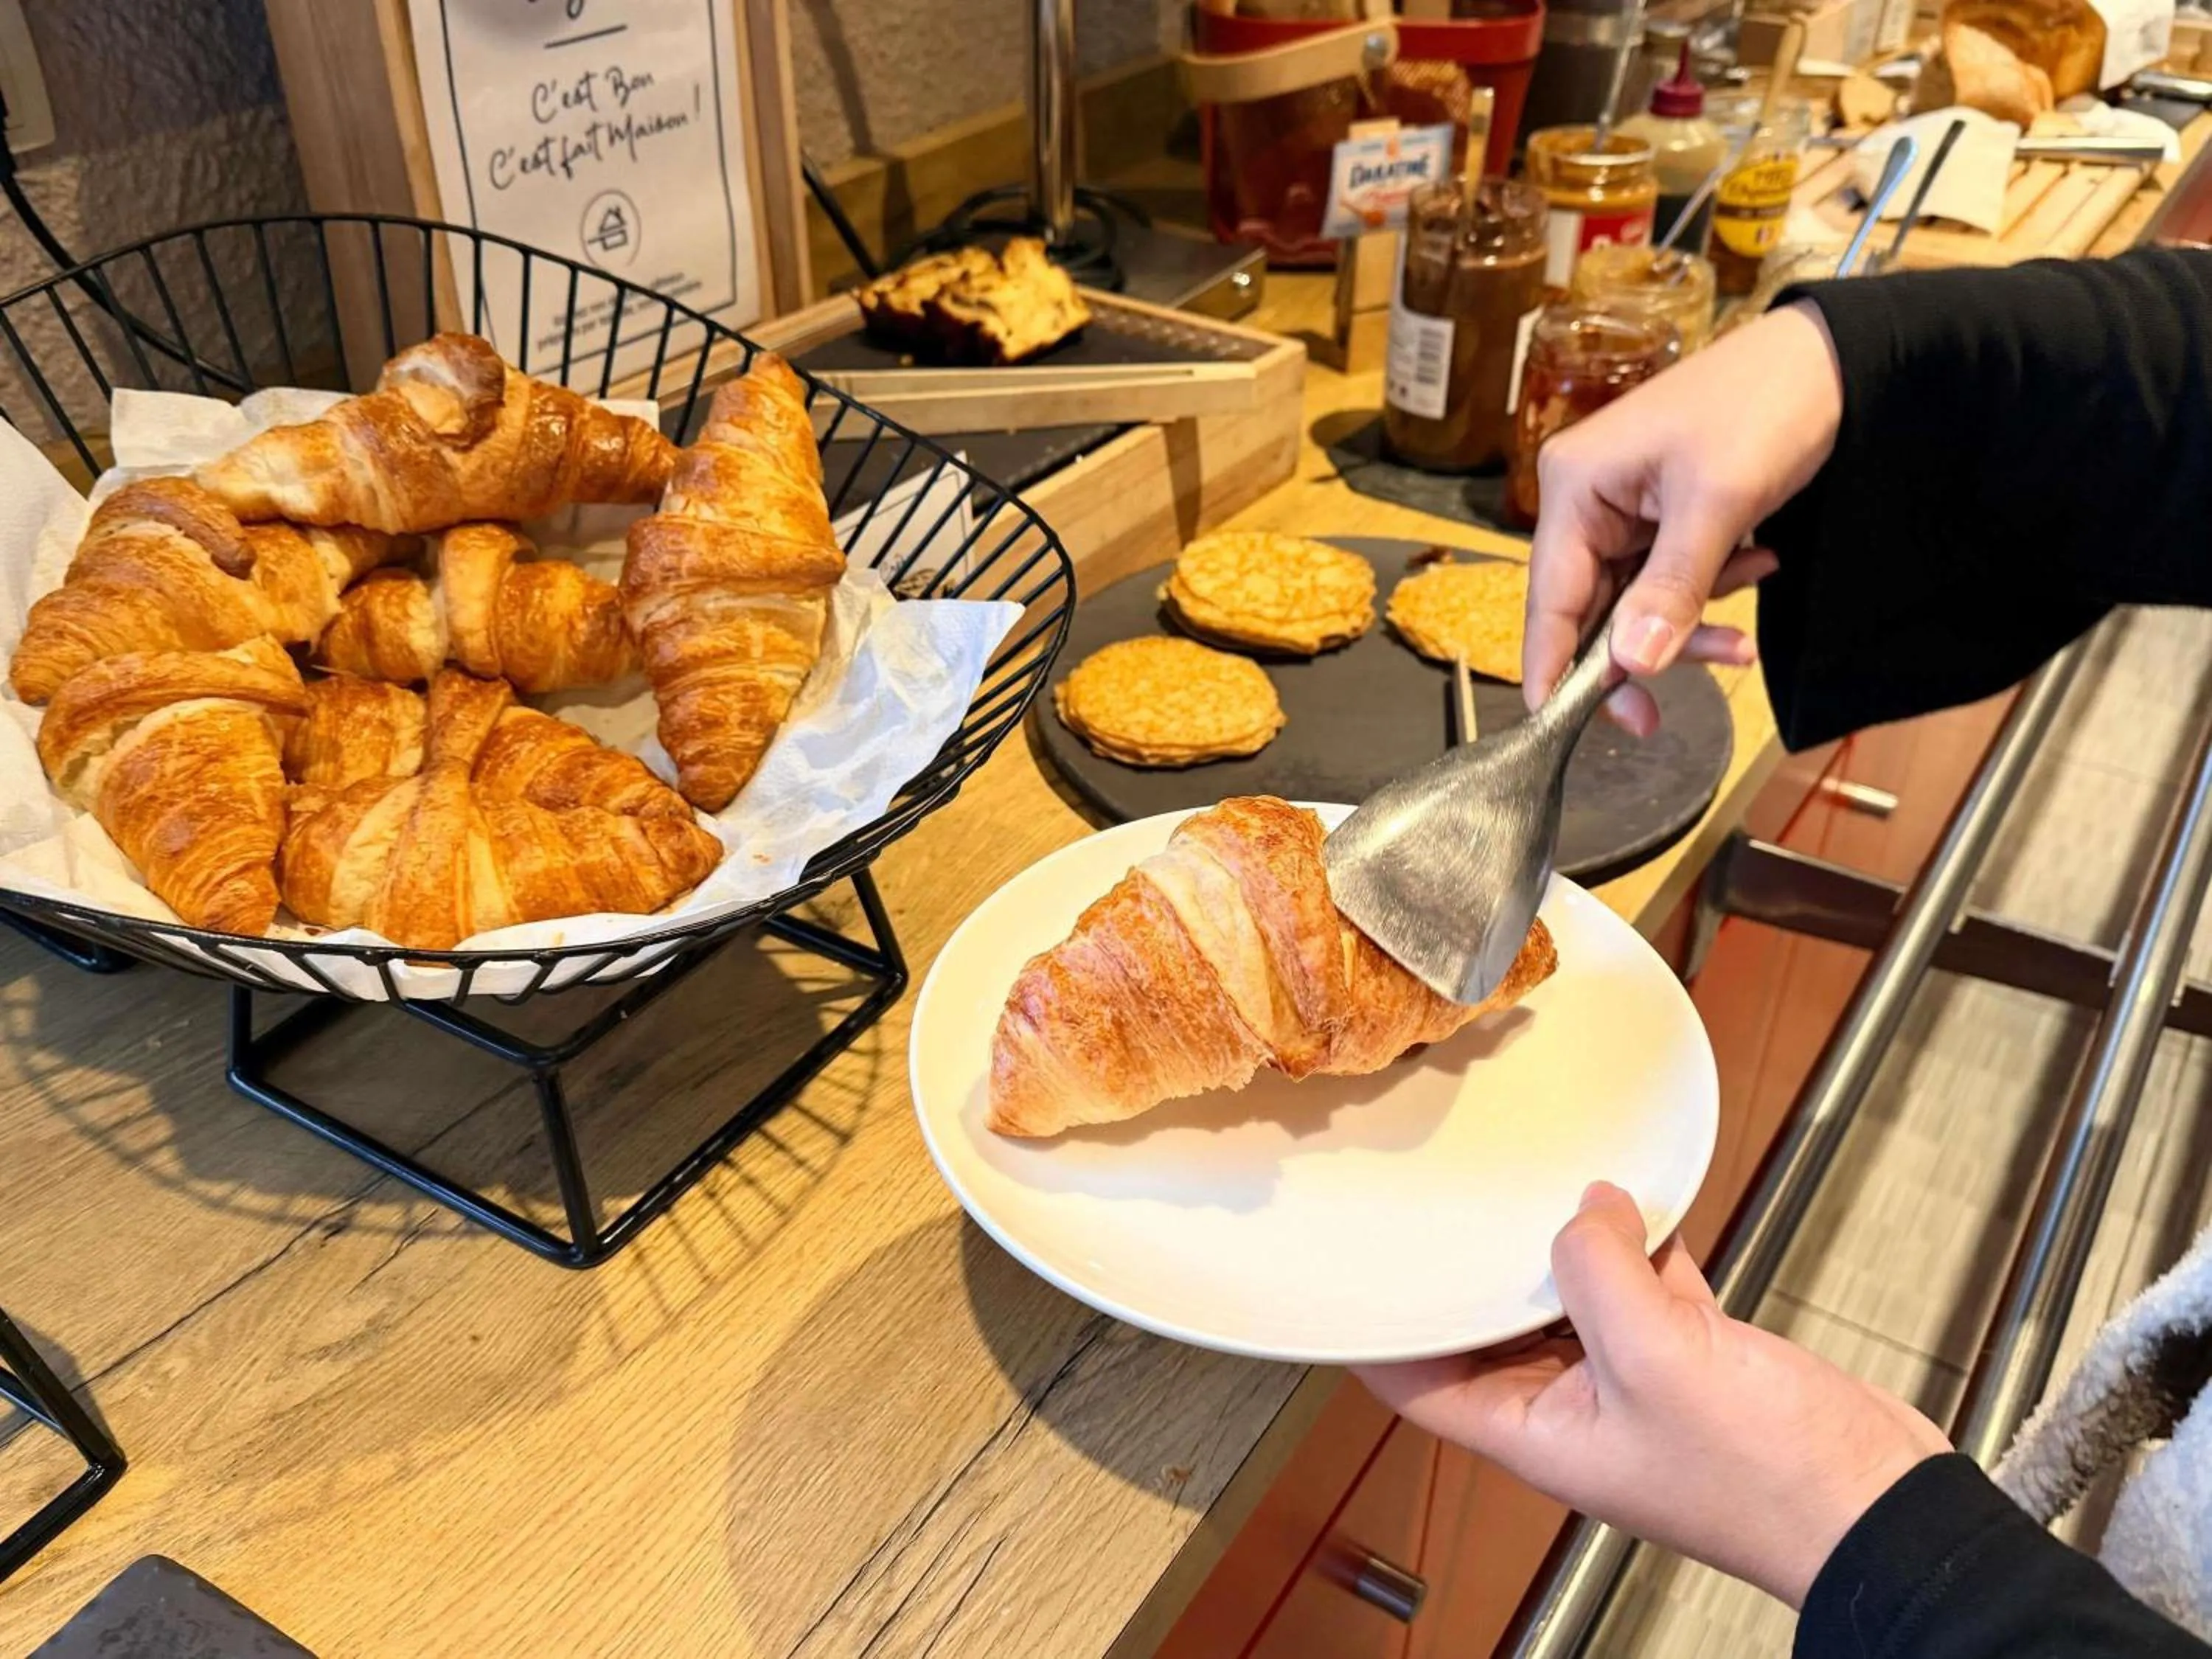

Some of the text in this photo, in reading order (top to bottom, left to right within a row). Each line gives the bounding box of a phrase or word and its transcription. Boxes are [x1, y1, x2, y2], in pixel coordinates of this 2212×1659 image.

[532, 66, 655, 124] C'est Bon
[489, 136, 556, 190] C'est
[560, 122, 603, 181] fait
